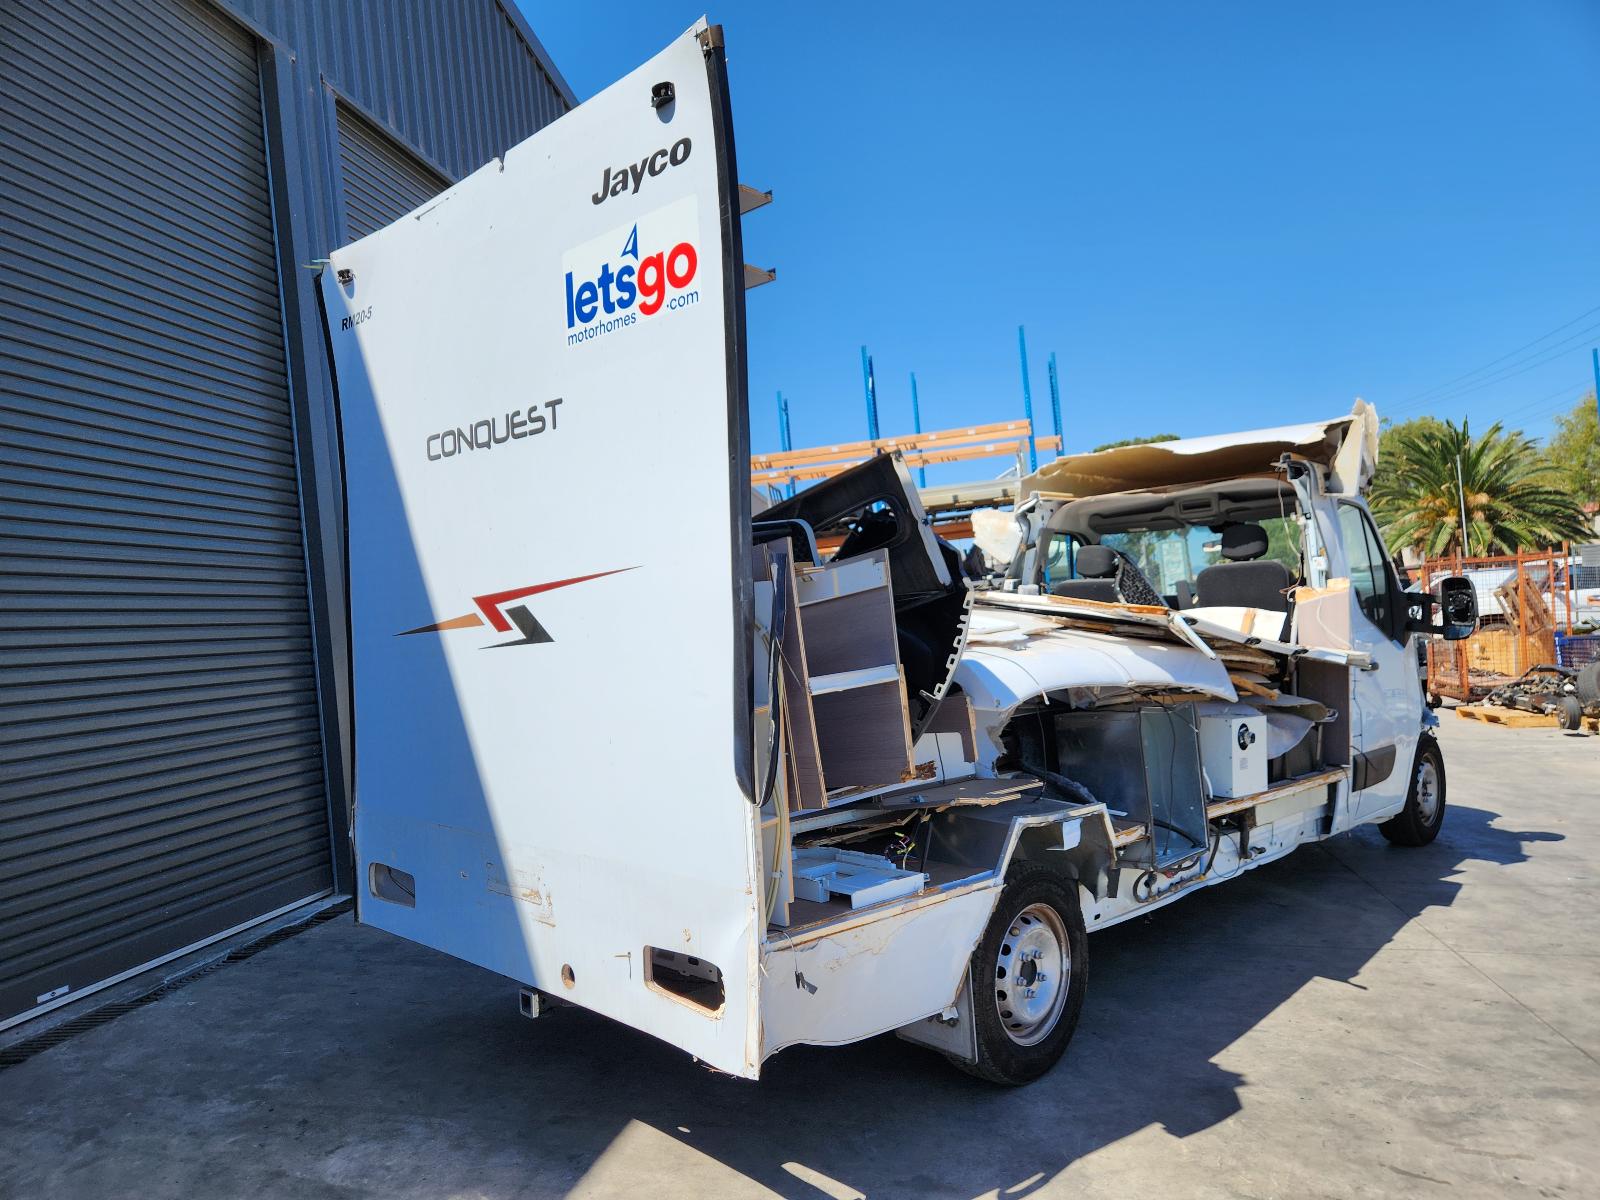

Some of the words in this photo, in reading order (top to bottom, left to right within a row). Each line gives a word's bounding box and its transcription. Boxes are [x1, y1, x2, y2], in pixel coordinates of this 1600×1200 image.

[591, 137, 692, 205] Jayco
[565, 242, 698, 329] letsgo
[567, 312, 637, 346] motorhomes
[427, 397, 563, 461] CONQUEST
